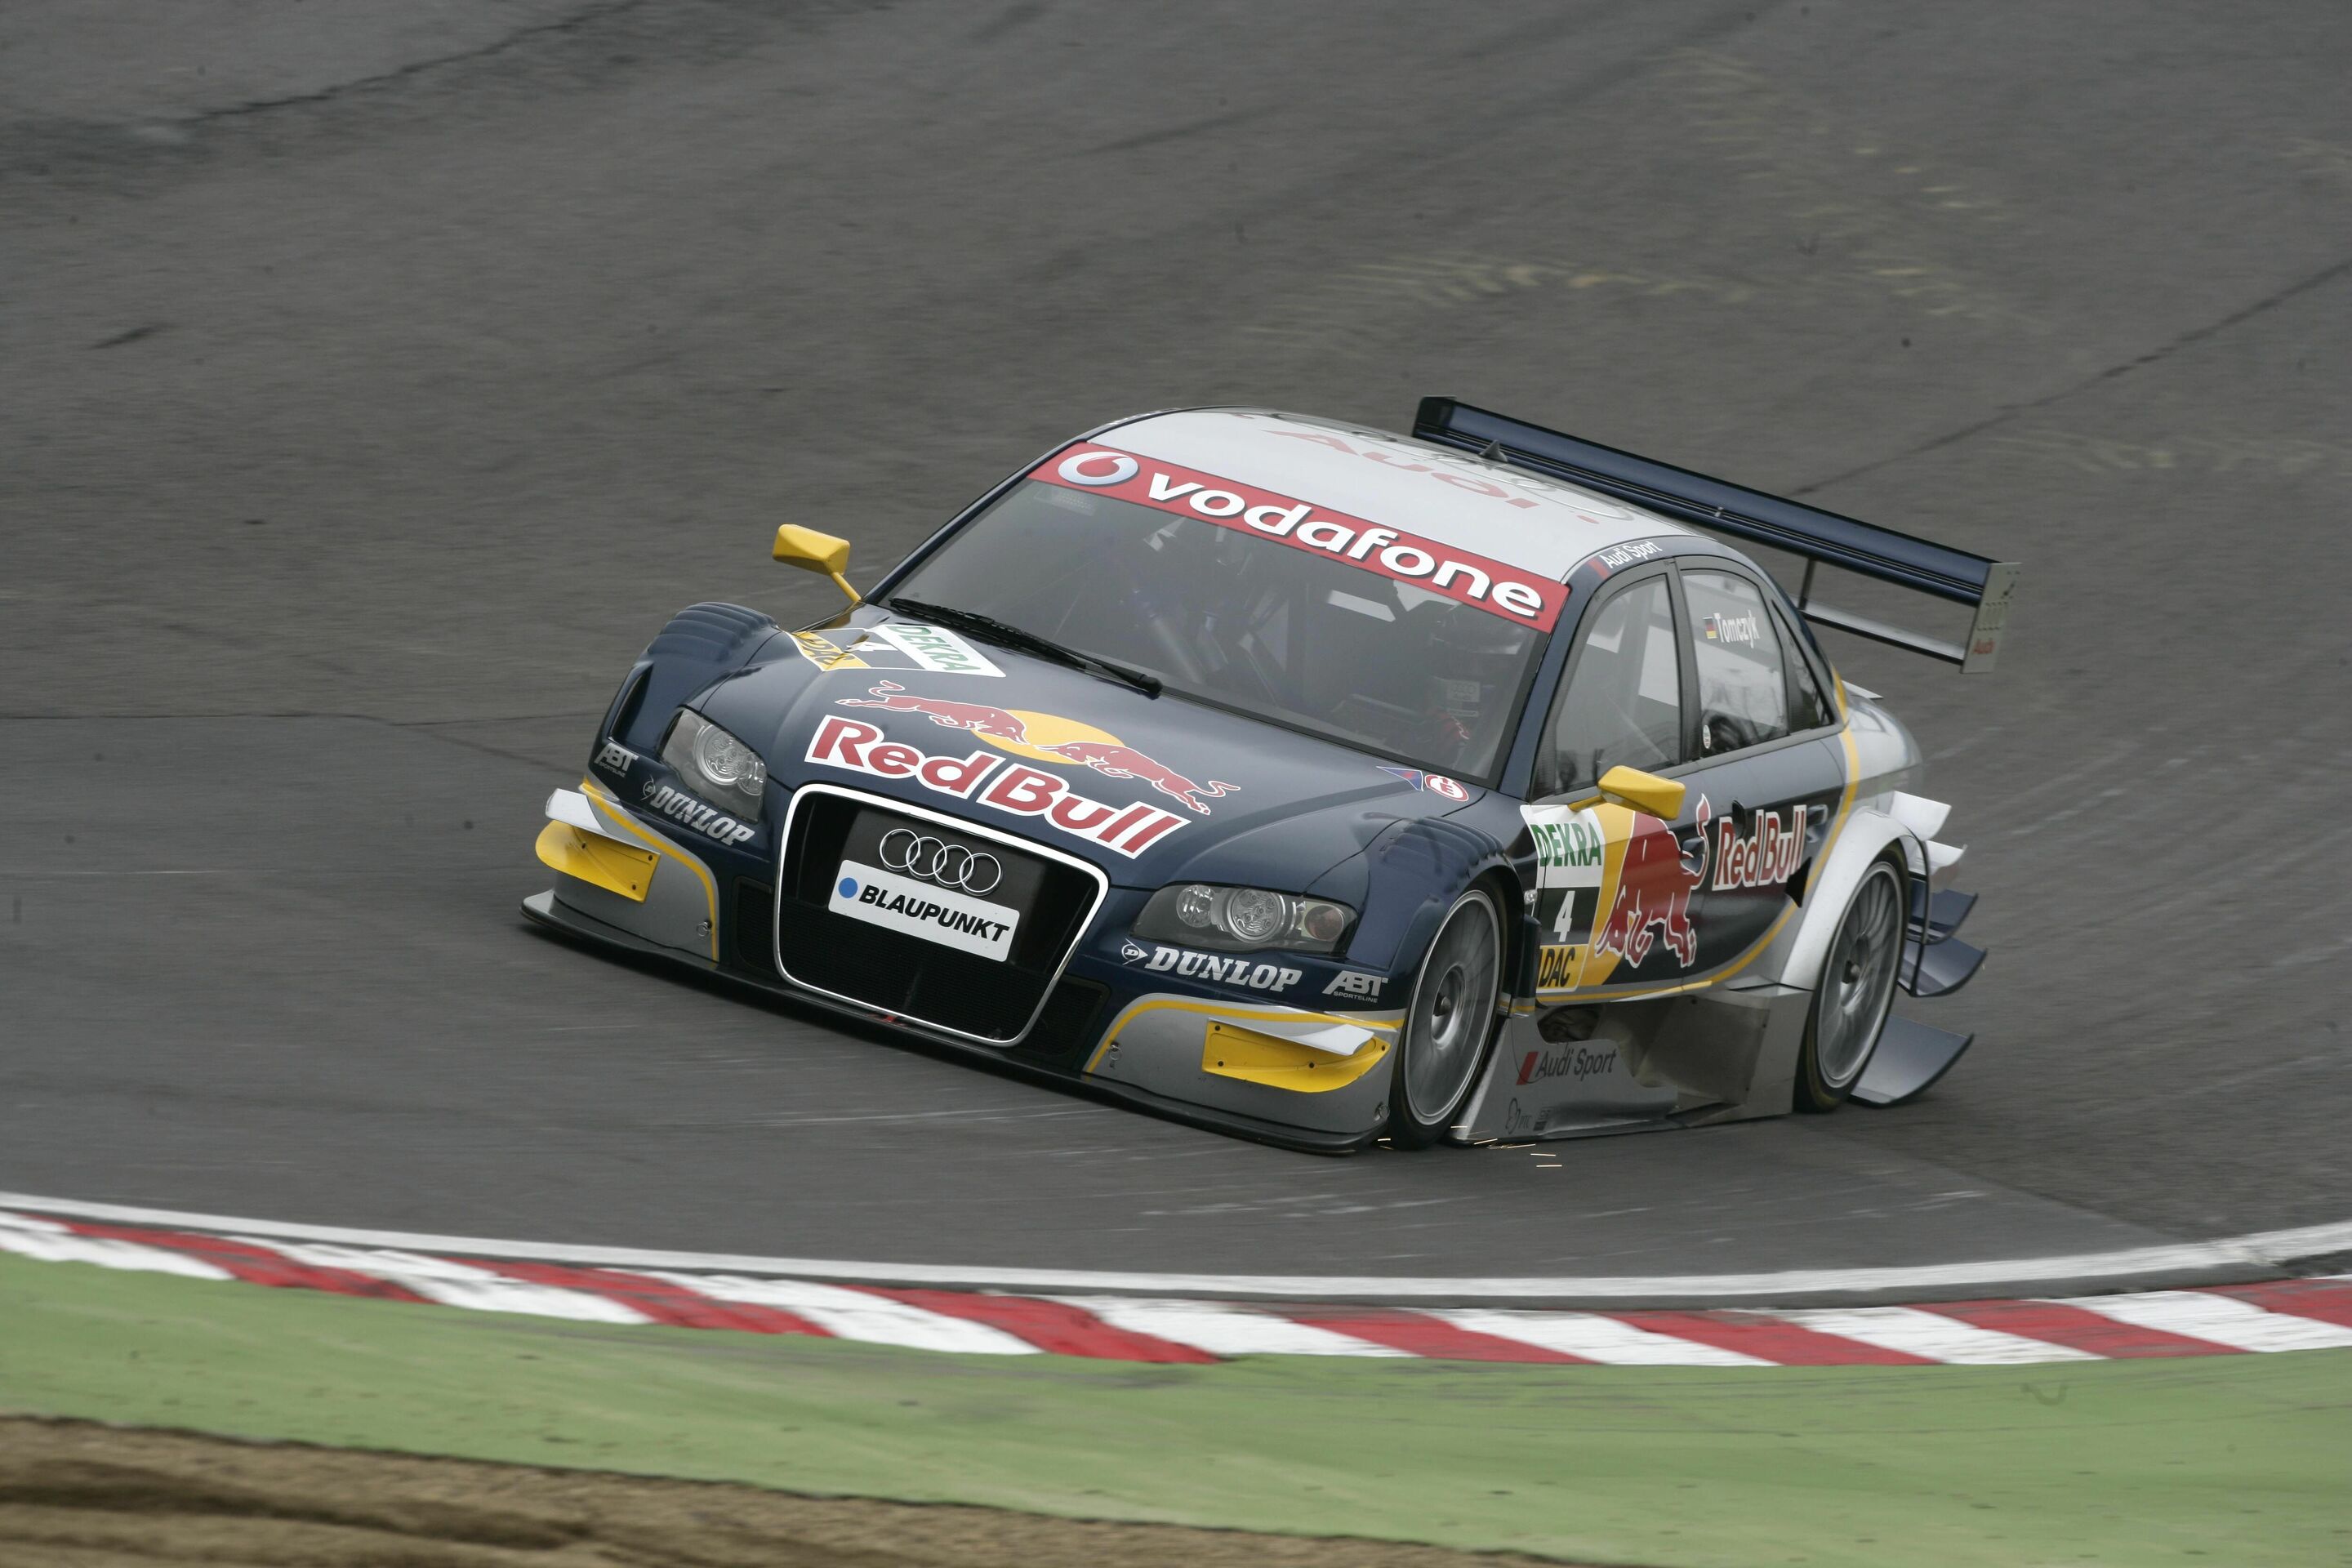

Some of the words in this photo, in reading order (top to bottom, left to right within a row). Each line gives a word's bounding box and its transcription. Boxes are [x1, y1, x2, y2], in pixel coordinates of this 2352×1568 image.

[1147, 472, 1544, 618] vodafone
[1598, 547, 1633, 569] Audi
[1622, 540, 1664, 560] Sport
[884, 625, 982, 672] DEKRA
[1713, 608, 1761, 649] Tomczyk
[594, 742, 639, 772] ABT
[650, 785, 755, 846] DUNLOP
[1530, 821, 1602, 867] DEKRA
[858, 884, 1010, 942] BLAUPUNKT
[1553, 890, 1576, 942] 4
[1144, 945, 1303, 992] DUNLOP
[1321, 969, 1388, 997] ABT
[1333, 991, 1379, 1004] SPORTSLINE
[1535, 1042, 1575, 1078] Audi
[1573, 1048, 1617, 1082] Sport
